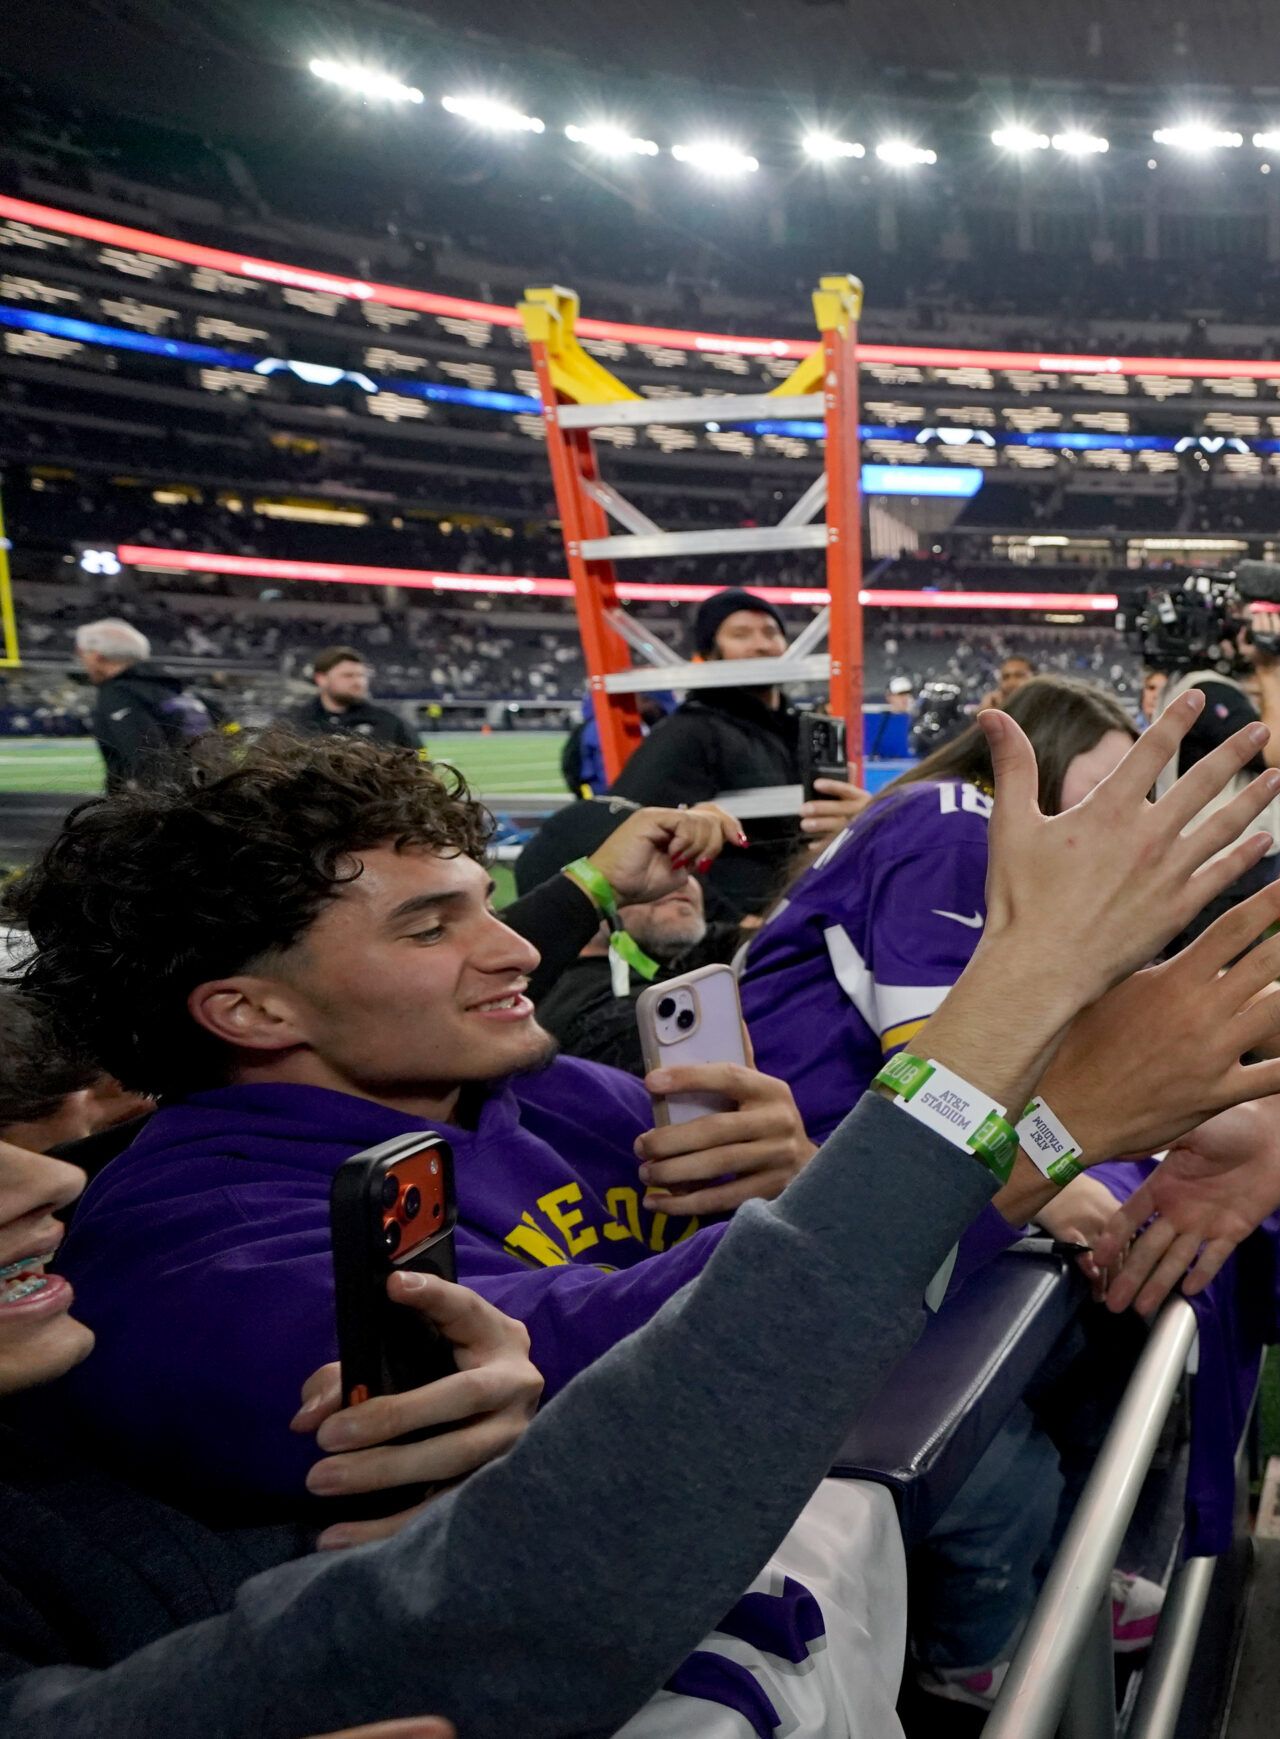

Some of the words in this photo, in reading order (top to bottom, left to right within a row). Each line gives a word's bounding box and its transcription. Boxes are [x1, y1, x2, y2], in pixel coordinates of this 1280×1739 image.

[920, 1092, 972, 1131] STADIUM
[938, 1089, 970, 1114] AT&T
[1029, 1130, 1051, 1151] AT&T
[1032, 1116, 1064, 1154] STADIUM
